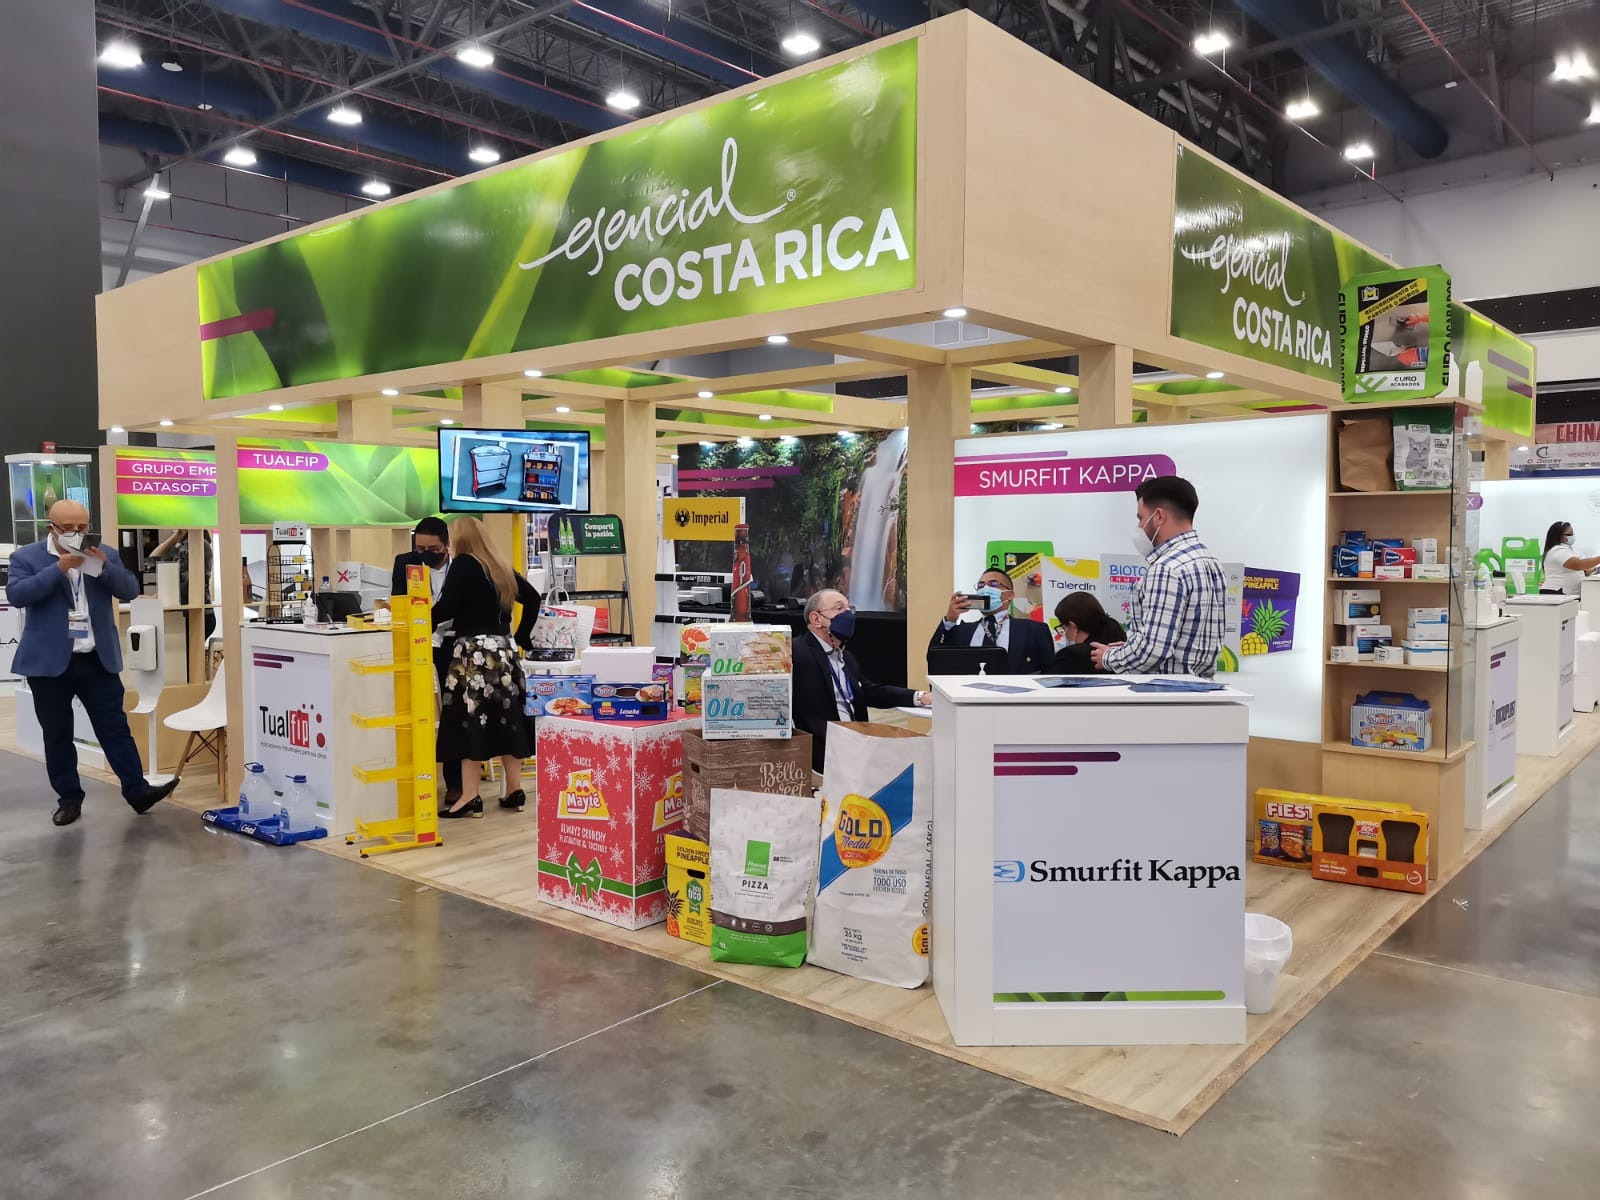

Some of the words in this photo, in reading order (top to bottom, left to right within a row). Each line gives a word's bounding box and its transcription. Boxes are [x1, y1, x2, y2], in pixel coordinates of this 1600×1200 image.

[518, 137, 787, 275] esencial
[615, 239, 765, 312] COSTA
[774, 207, 910, 283] RICA
[1232, 297, 1293, 355] COSTA
[1295, 320, 1333, 368] RICA
[132, 463, 184, 475] GRUPO
[253, 453, 319, 467] TUALFIP
[978, 466, 1071, 489] SMURFIT
[1079, 463, 1158, 484] KAPPA
[132, 481, 209, 493] DATASOFT
[692, 511, 729, 526] Imperial
[713, 658, 745, 674] Ola
[707, 697, 746, 718] Ola
[760, 761, 807, 788] Bella
[566, 791, 602, 813] Mayté
[561, 823, 581, 836] ALWAYS
[839, 810, 882, 838] GOLD
[677, 851, 709, 866] PINEAPPLE
[874, 877, 891, 887] TODO
[893, 878, 907, 888] USO
[1030, 859, 1142, 882] Smurfit
[1148, 860, 1241, 888] Kappa
[742, 879, 769, 890] PIZZA
